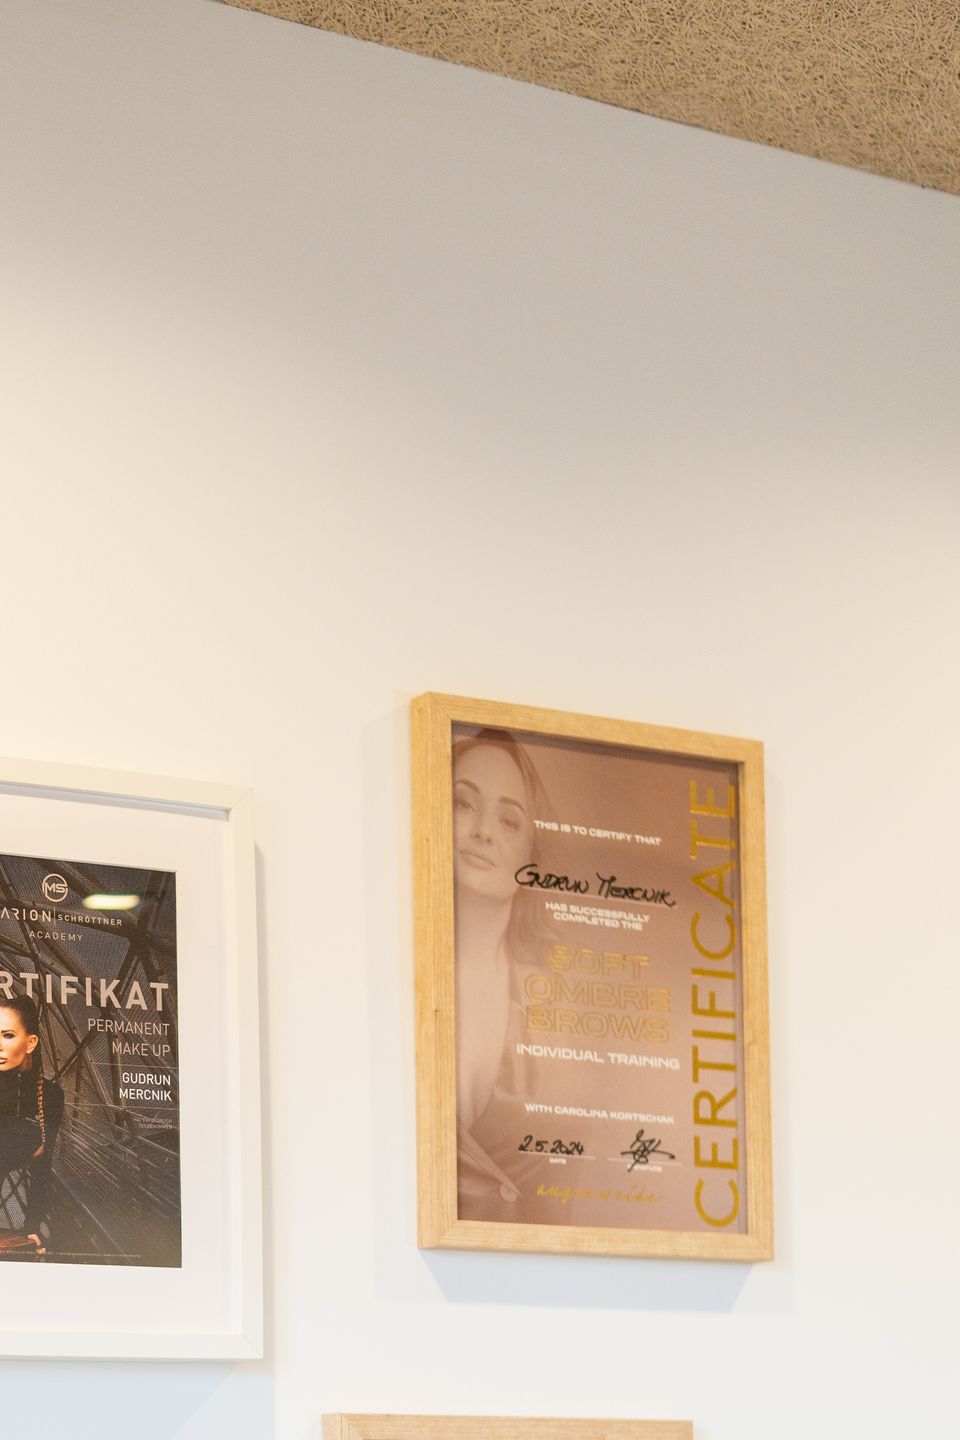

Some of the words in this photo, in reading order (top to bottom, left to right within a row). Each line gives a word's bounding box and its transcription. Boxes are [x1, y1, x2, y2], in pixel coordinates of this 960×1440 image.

[534, 820, 558, 831] THIS
[561, 823, 571, 833] IS
[572, 825, 587, 835] TO
[589, 828, 632, 842] CERTIFY
[635, 834, 661, 846] THAT
[545, 902, 567, 911] HAS
[569, 904, 650, 922] SUCCESSFULLY
[553, 912, 620, 928] COMPLETED
[621, 920, 642, 931] THE
[29, 930, 83, 942] ACADEMY
[548, 944, 650, 980] SOFT
[524, 973, 671, 1012] OMBRE
[689, 779, 739, 1228] CERTIFICATE
[88, 1018, 170, 1036] PERMANENT
[527, 1005, 670, 1043] BROWS
[112, 1041, 147, 1056] MAKE
[152, 1044, 170, 1057] UP
[516, 1043, 604, 1063] INDIVIDUAL
[608, 1052, 680, 1070] TRAINING
[122, 1072, 171, 1086] GUDRUN
[119, 1088, 172, 1101] MERCNIK
[525, 1103, 552, 1113] WITH
[554, 1105, 608, 1119] CAROLINA
[610, 1111, 674, 1124] KORTSCHAK
[518, 1134, 584, 1156] 2.5.2024
